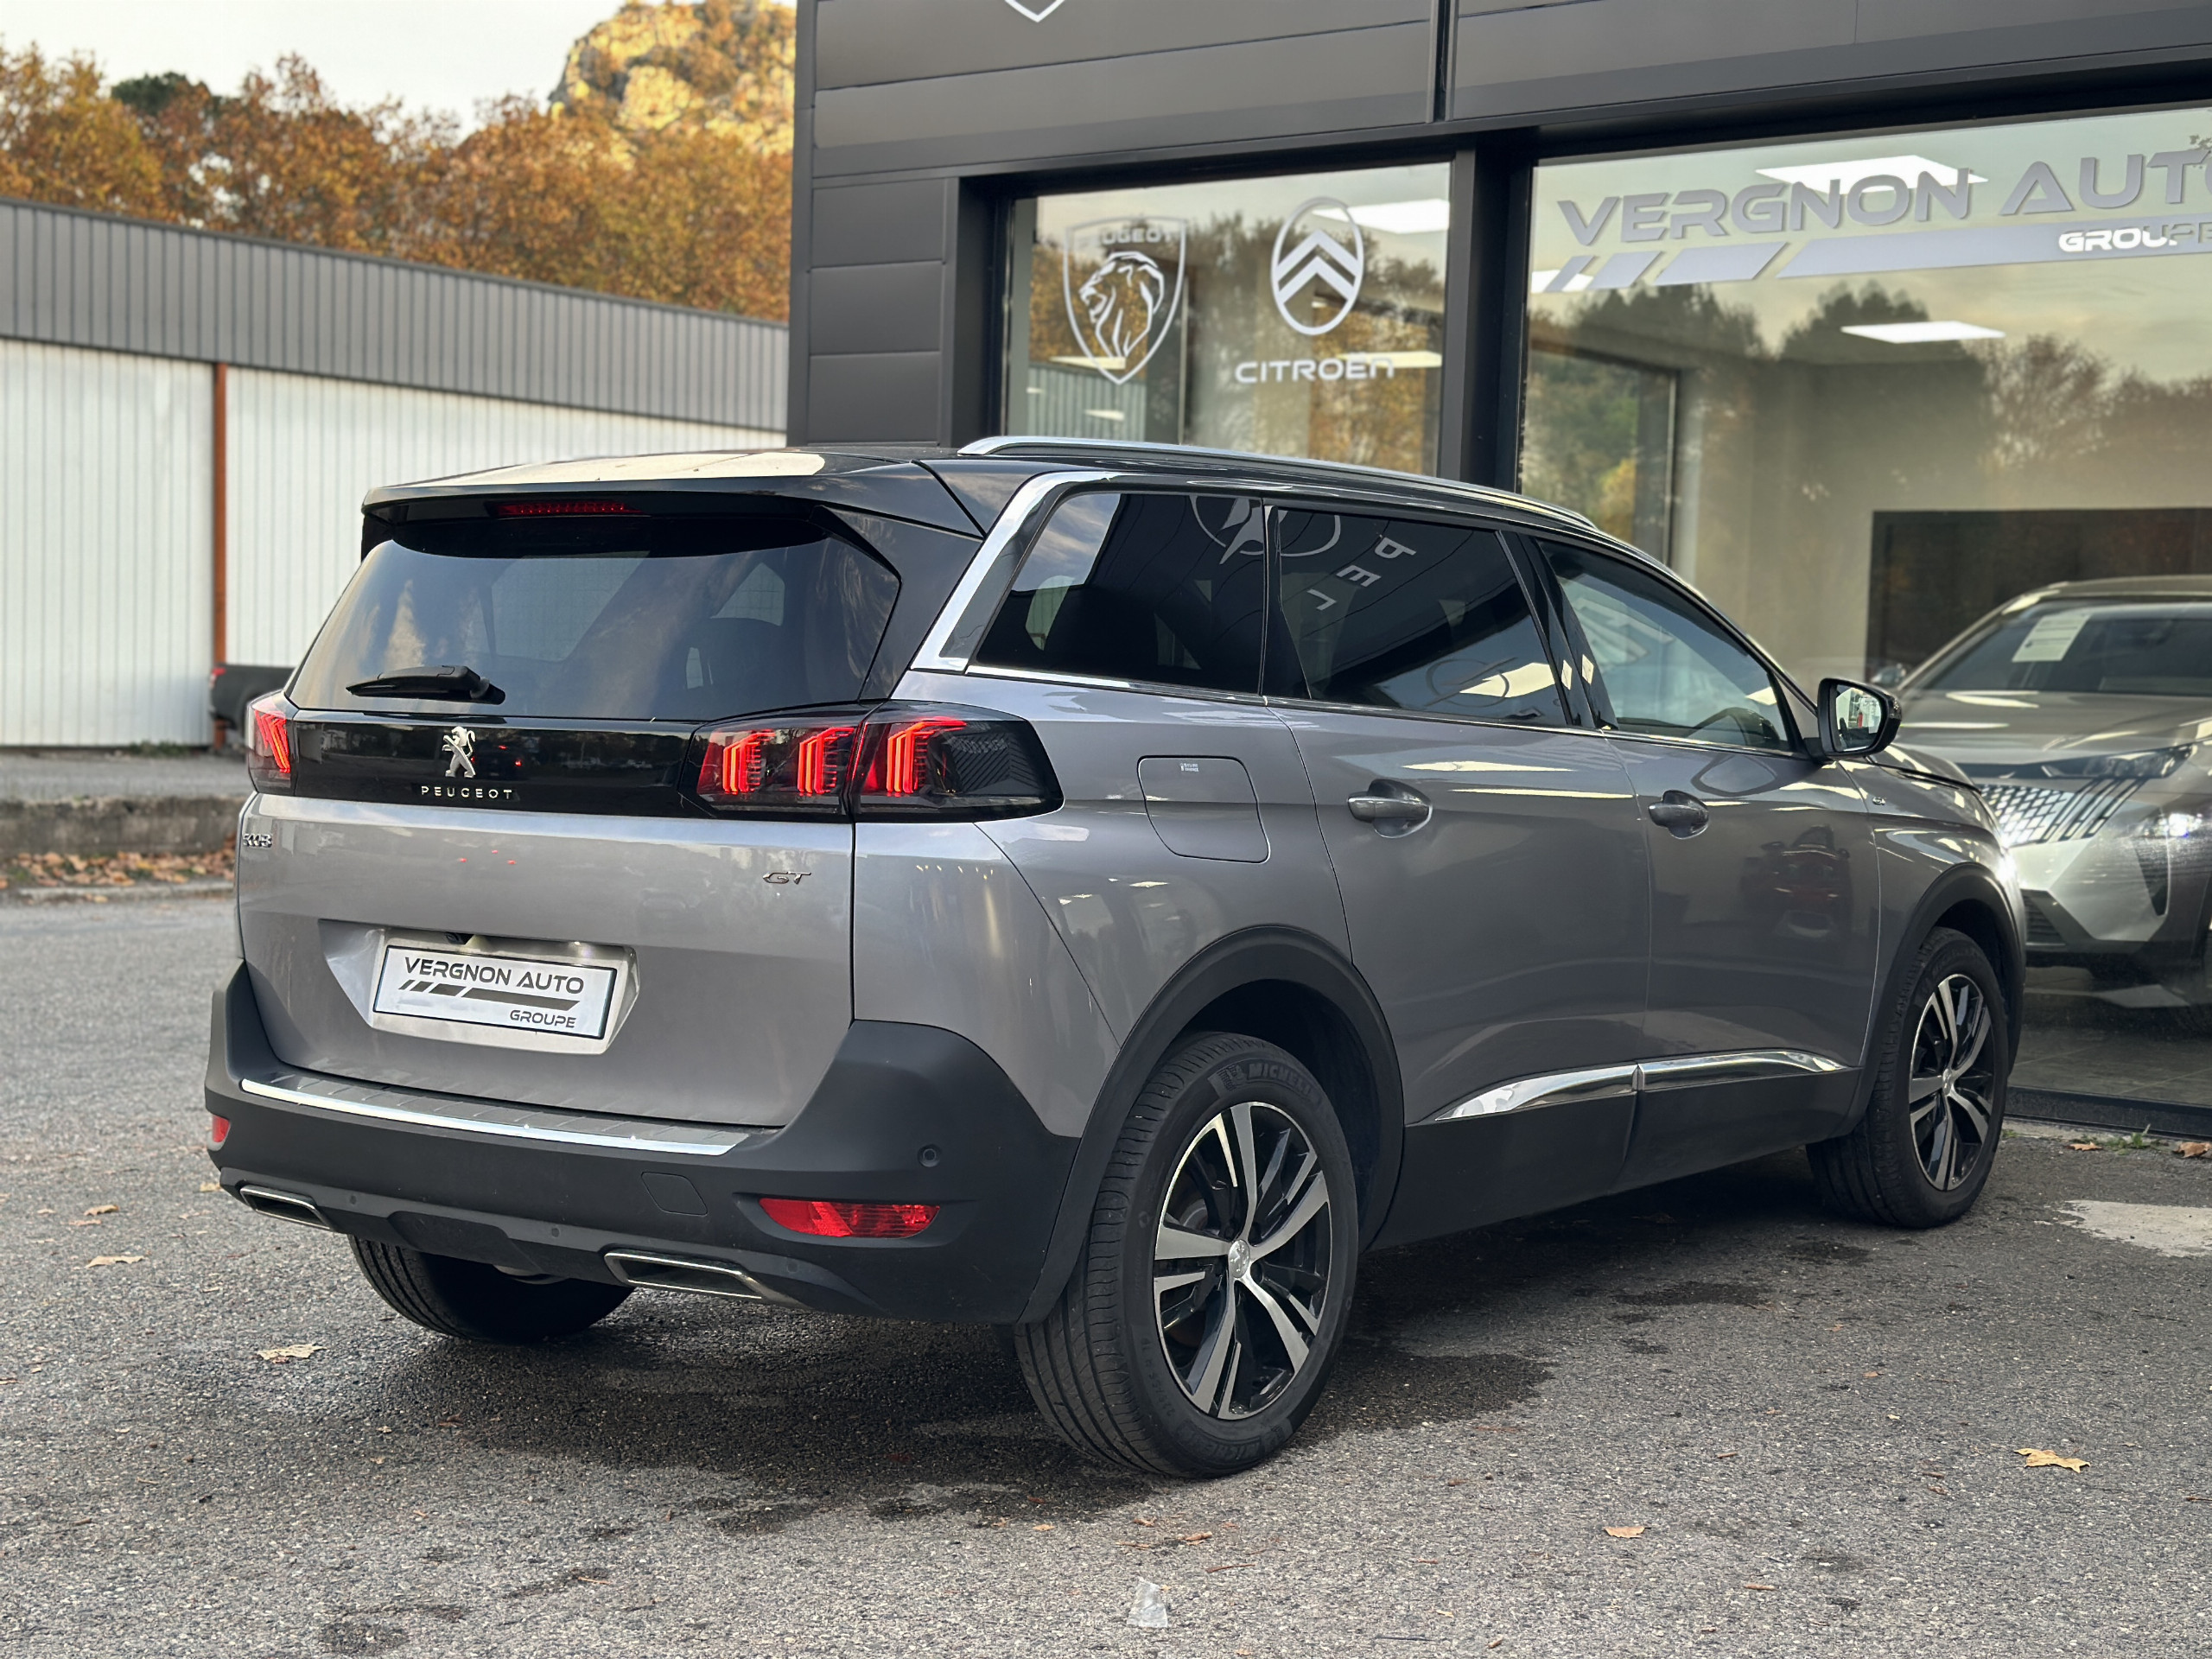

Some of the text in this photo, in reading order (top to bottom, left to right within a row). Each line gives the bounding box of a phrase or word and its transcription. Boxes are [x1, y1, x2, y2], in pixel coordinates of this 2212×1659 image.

[1557, 149, 2212, 247] VERGNON AUT
[421, 785, 512, 800] PEUGEOT
[762, 871, 812, 885] GT
[404, 957, 585, 995] VERGNON AUTO
[509, 1009, 577, 1028] GROUPE
